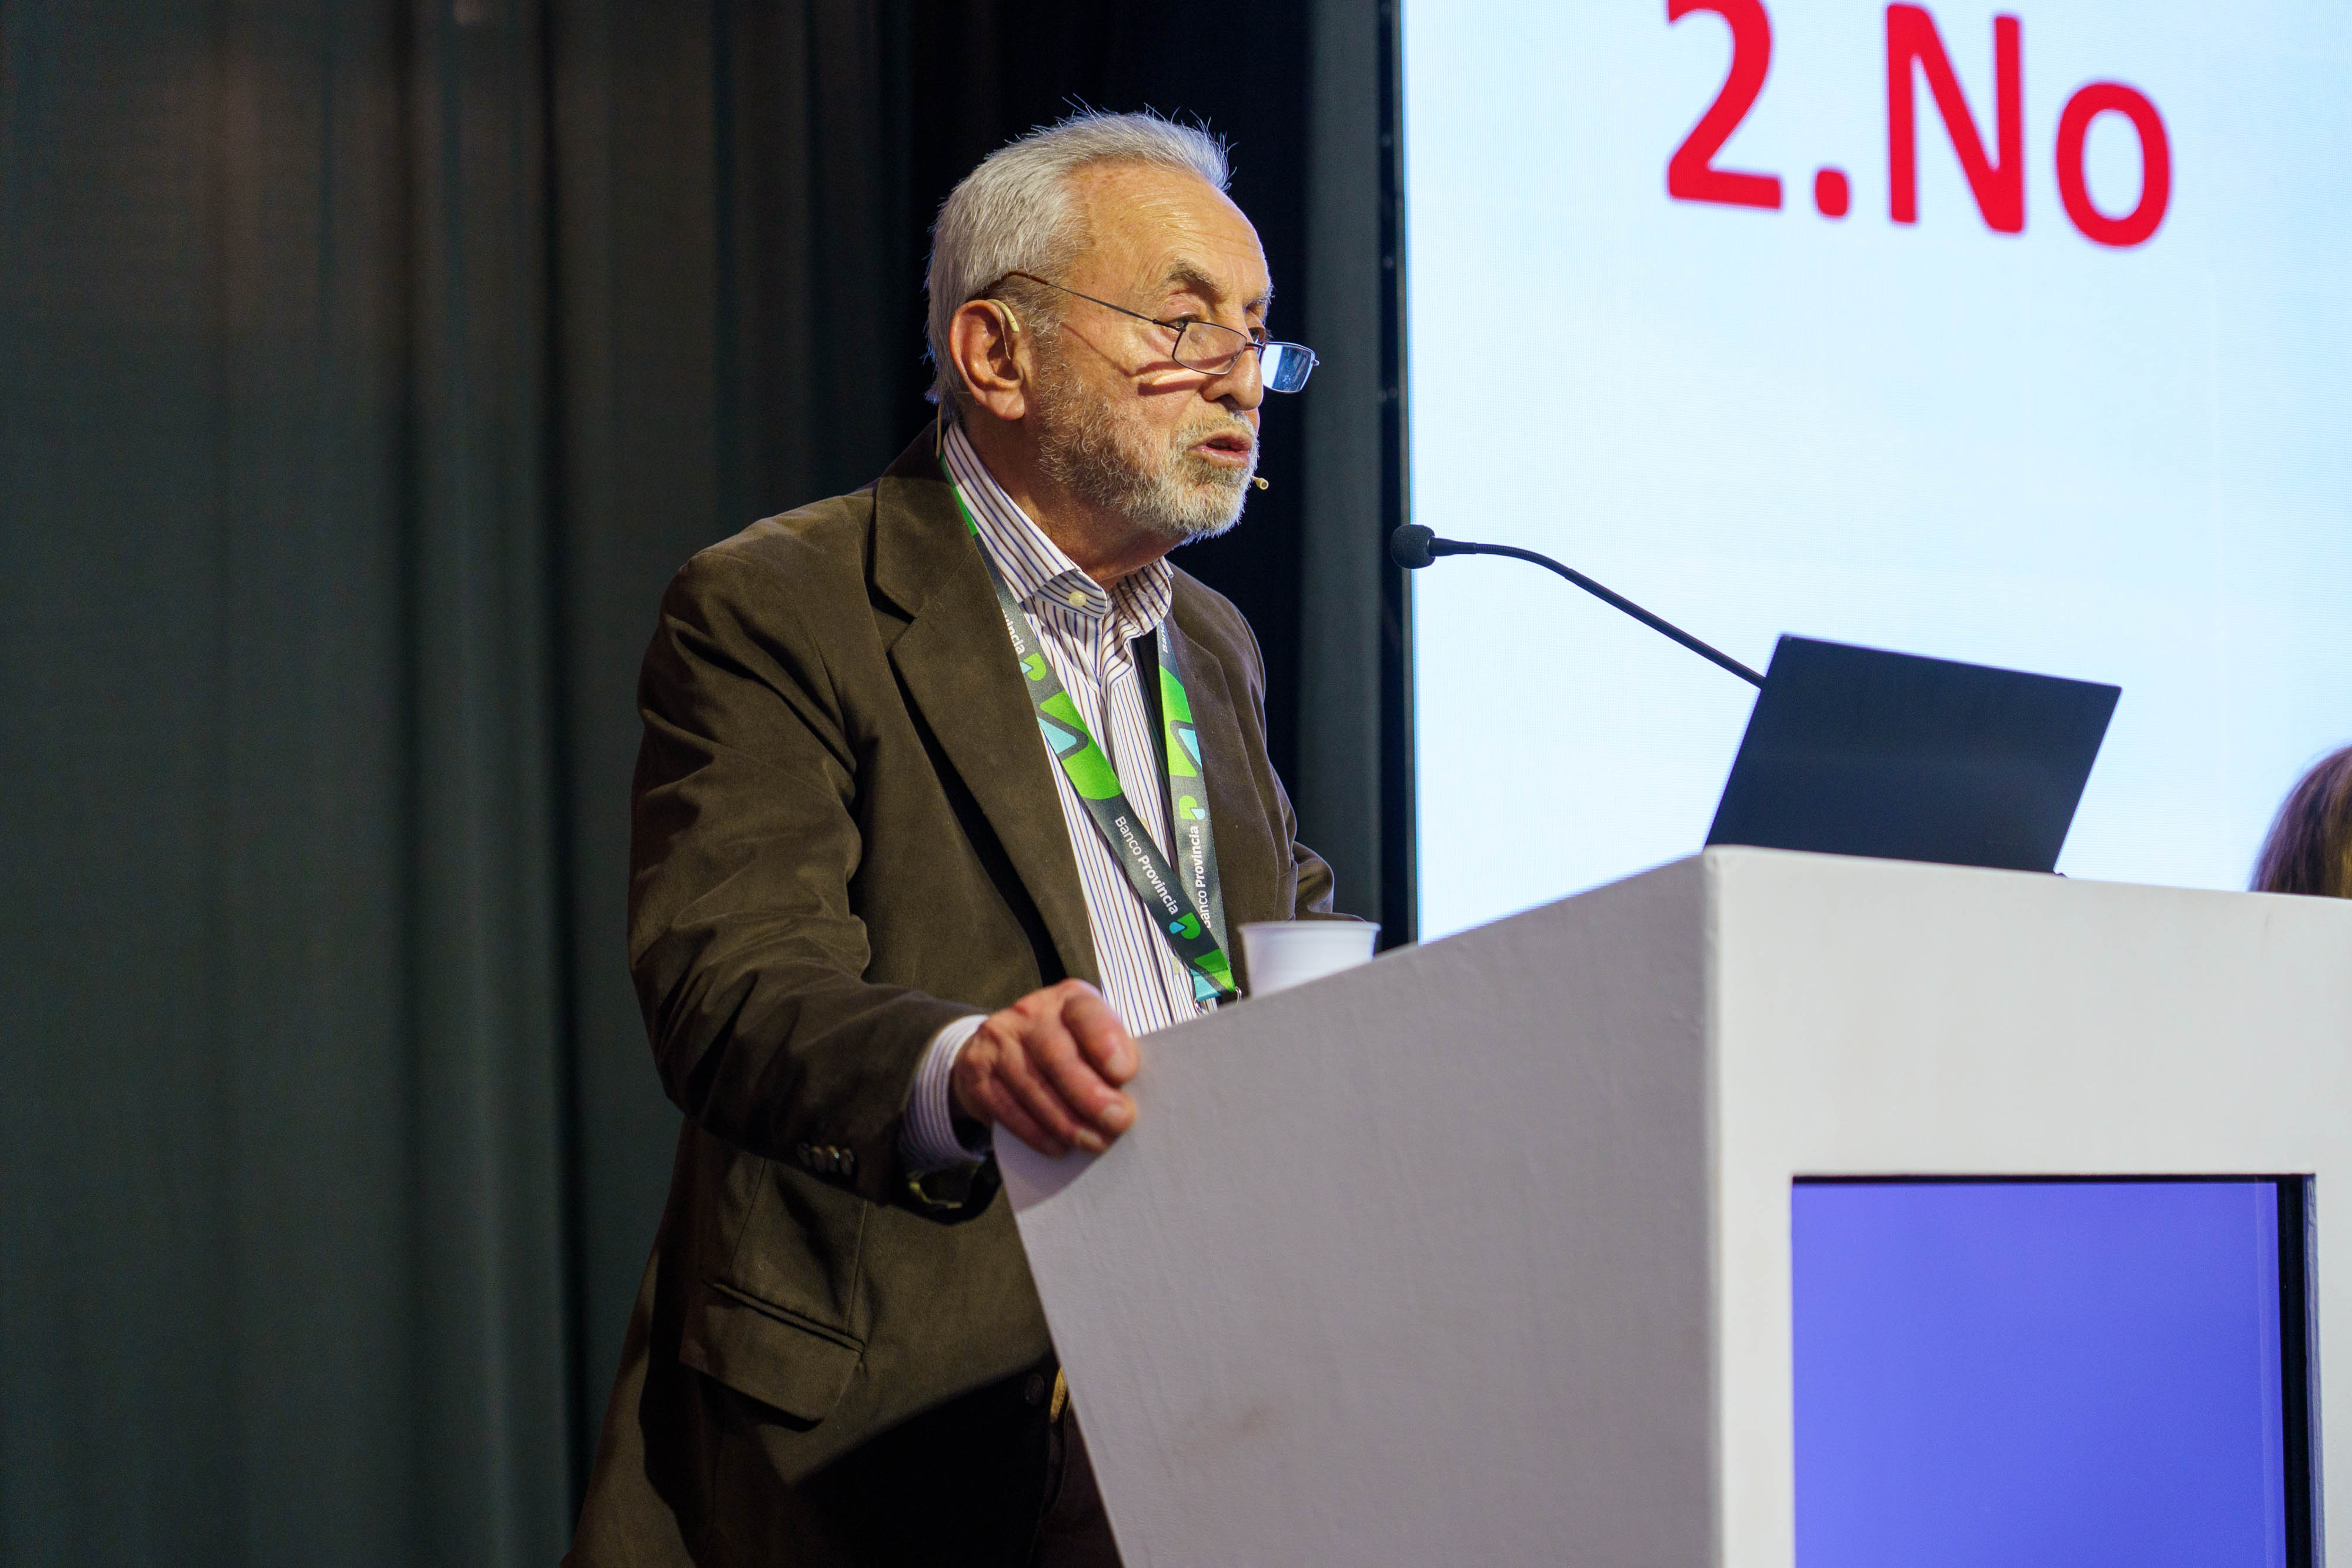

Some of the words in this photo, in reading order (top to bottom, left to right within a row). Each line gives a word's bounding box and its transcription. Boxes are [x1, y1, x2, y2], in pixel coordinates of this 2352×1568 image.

[1115, 815, 1142, 855] Banco
[1138, 855, 1178, 915] Provincia
[1189, 825, 1205, 888] Provincia
